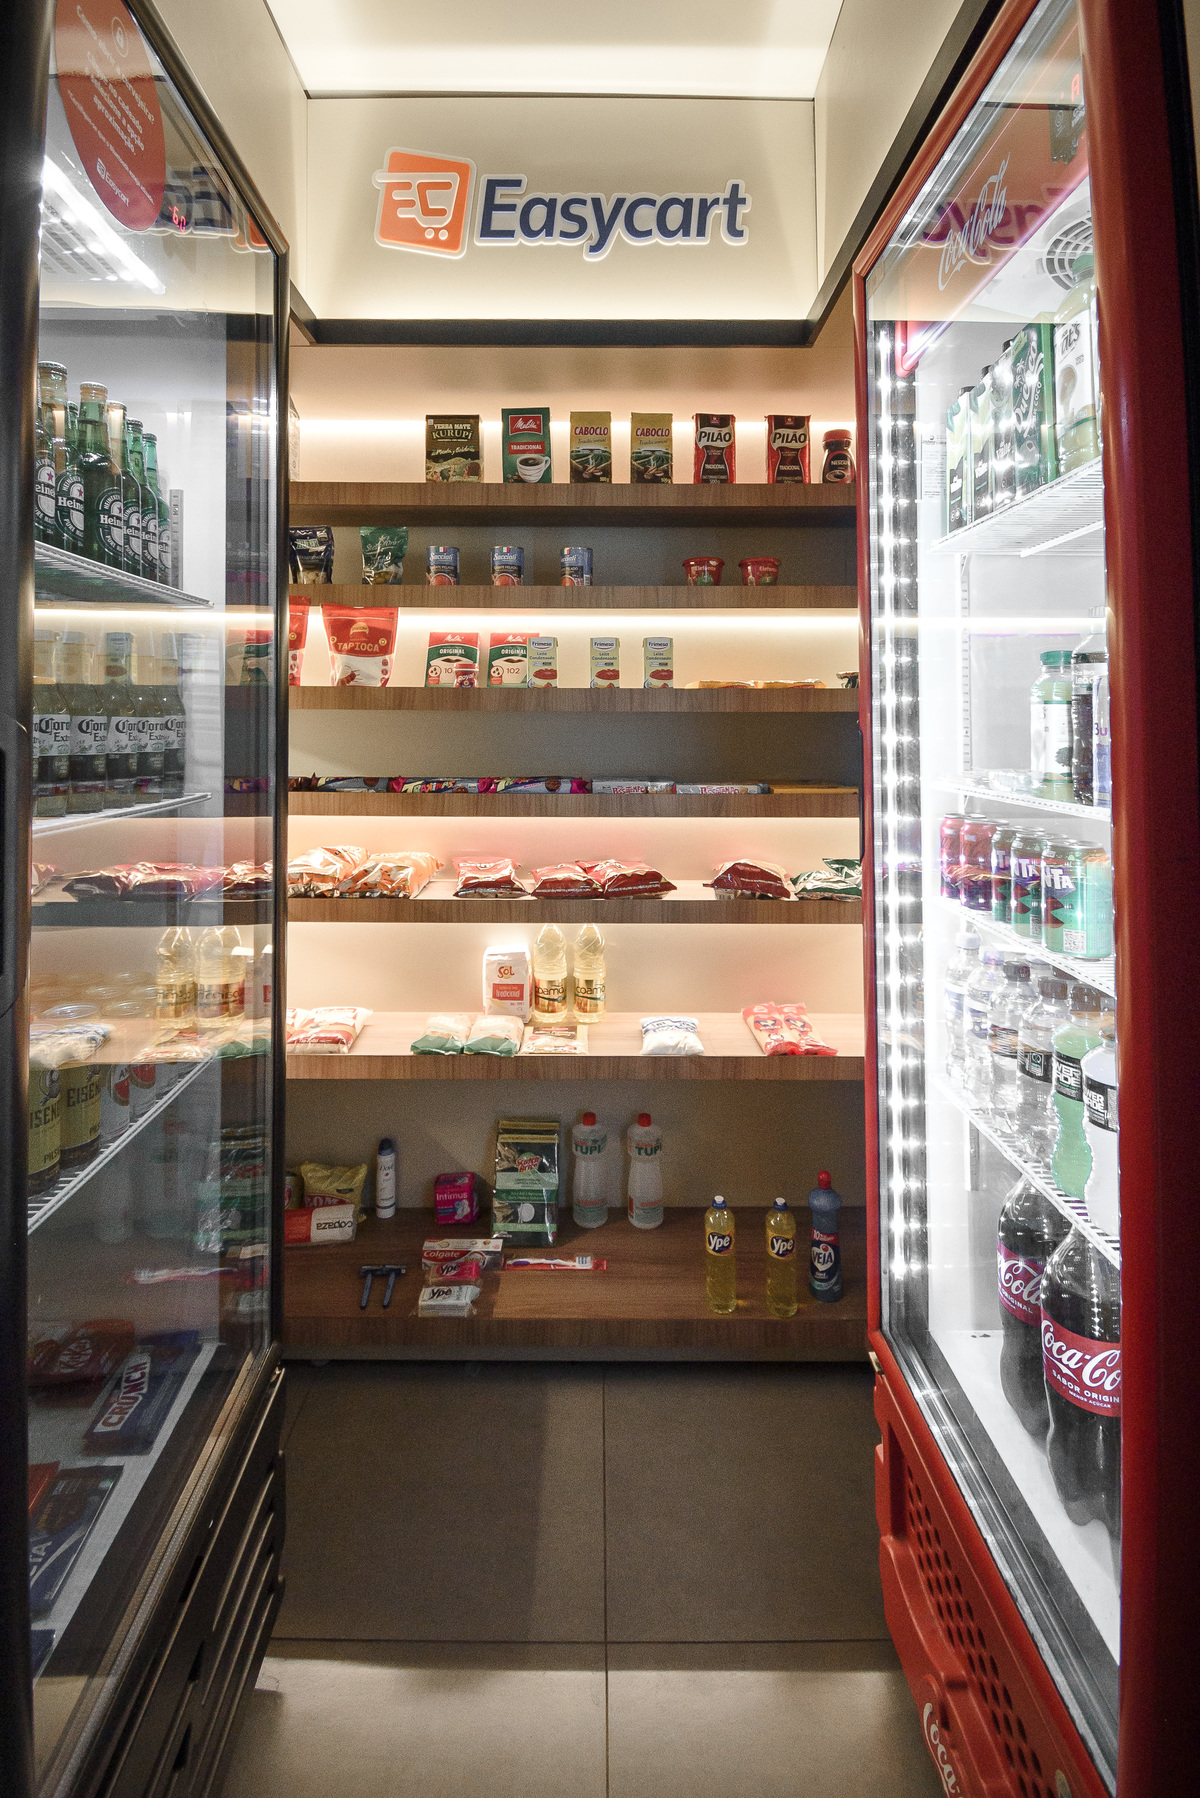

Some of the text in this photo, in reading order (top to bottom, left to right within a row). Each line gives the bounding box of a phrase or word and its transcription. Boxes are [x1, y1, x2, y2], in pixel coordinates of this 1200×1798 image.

[122, 73, 155, 124] cervejeira?
[118, 96, 143, 134] cadeado
[479, 178, 747, 254] Easycart
[938, 152, 1010, 291] Coca-Cola
[513, 418, 538, 429] Melitta
[574, 426, 609, 436] CABOCLO
[636, 427, 670, 437] CABOCLO
[698, 430, 732, 443] PILÃO
[772, 430, 808, 444] PILÃO
[337, 642, 380, 652] TAPIOCA
[401, 780, 456, 793] TRAKINAS
[436, 1192, 468, 1201] Intimus
[424, 1250, 460, 1259] Colgate
[812, 1251, 833, 1265] VEJA
[1052, 1369, 1081, 1394] SABOR
[101, 1360, 148, 1428] CRUNCH
[923, 1702, 964, 1798] Coca-
